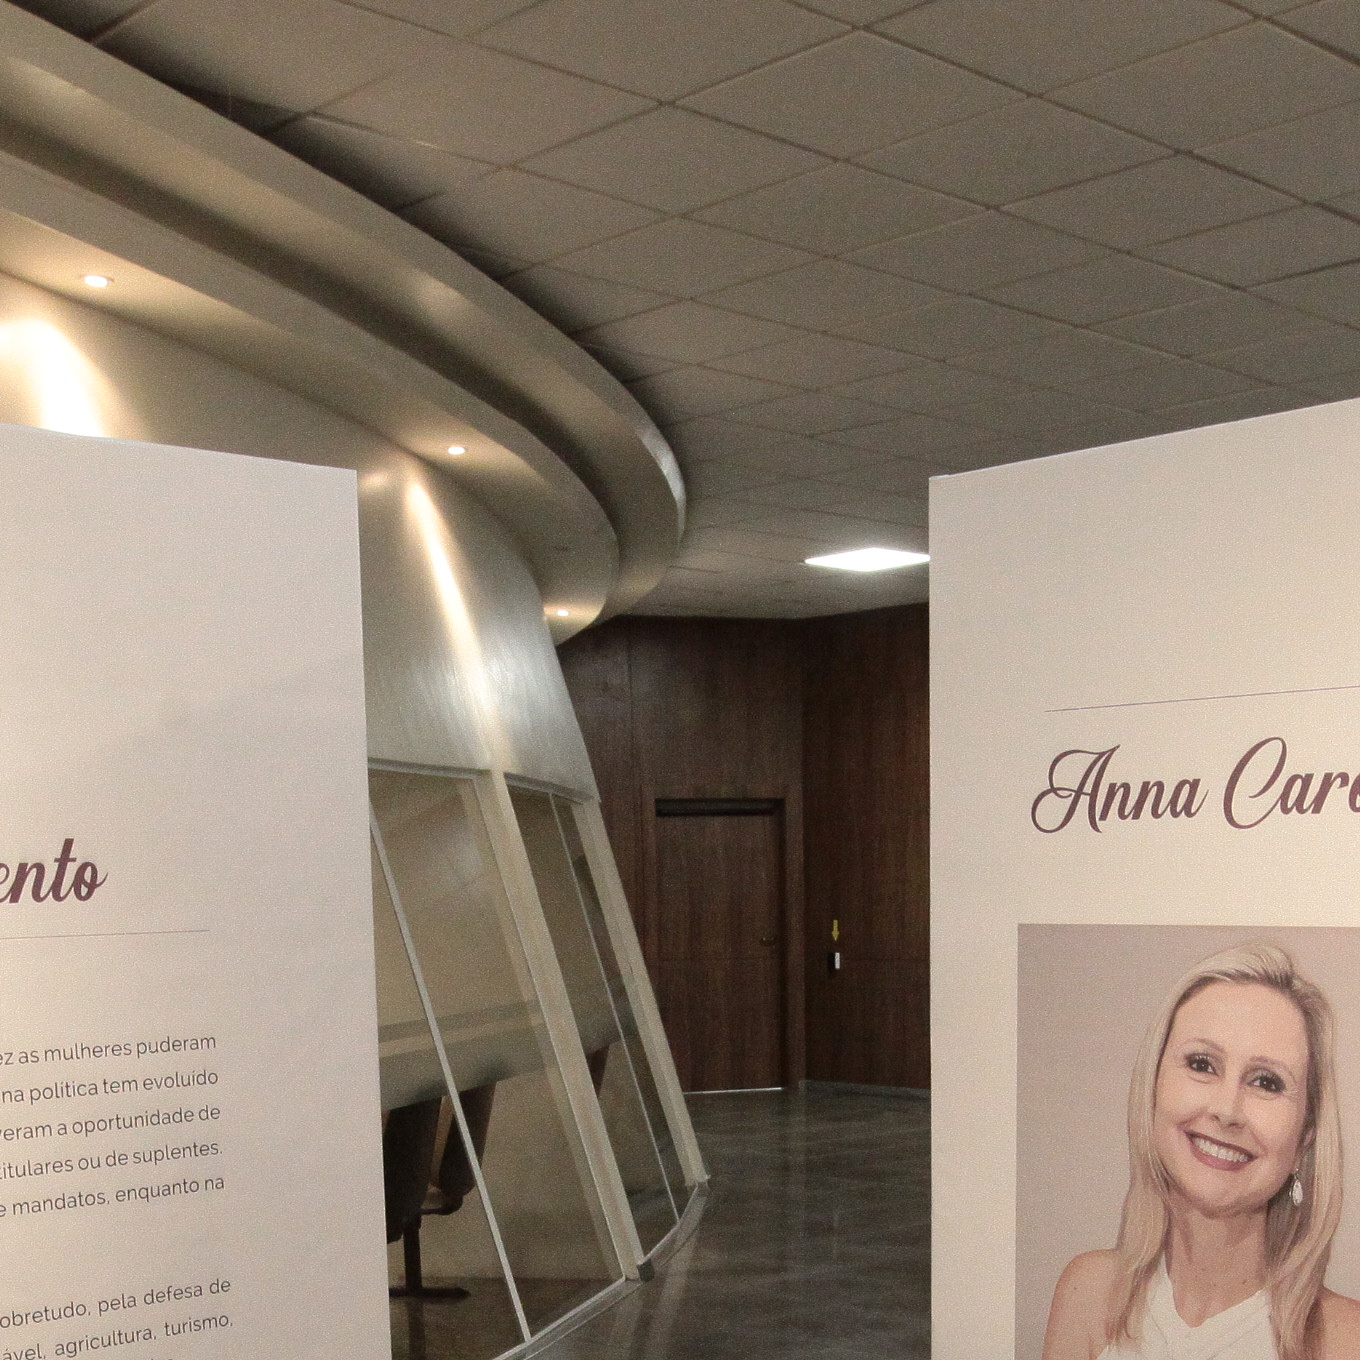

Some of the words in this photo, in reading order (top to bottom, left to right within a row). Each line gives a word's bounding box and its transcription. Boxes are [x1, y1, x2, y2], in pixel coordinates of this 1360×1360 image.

[1031, 744, 1208, 834] Anna
[18, 1049, 39, 1064] as
[43, 1042, 132, 1061] mulheres
[136, 1035, 216, 1058] puderam
[54, 1327, 157, 1358] agricultura,
[163, 1314, 233, 1336] turismo,
